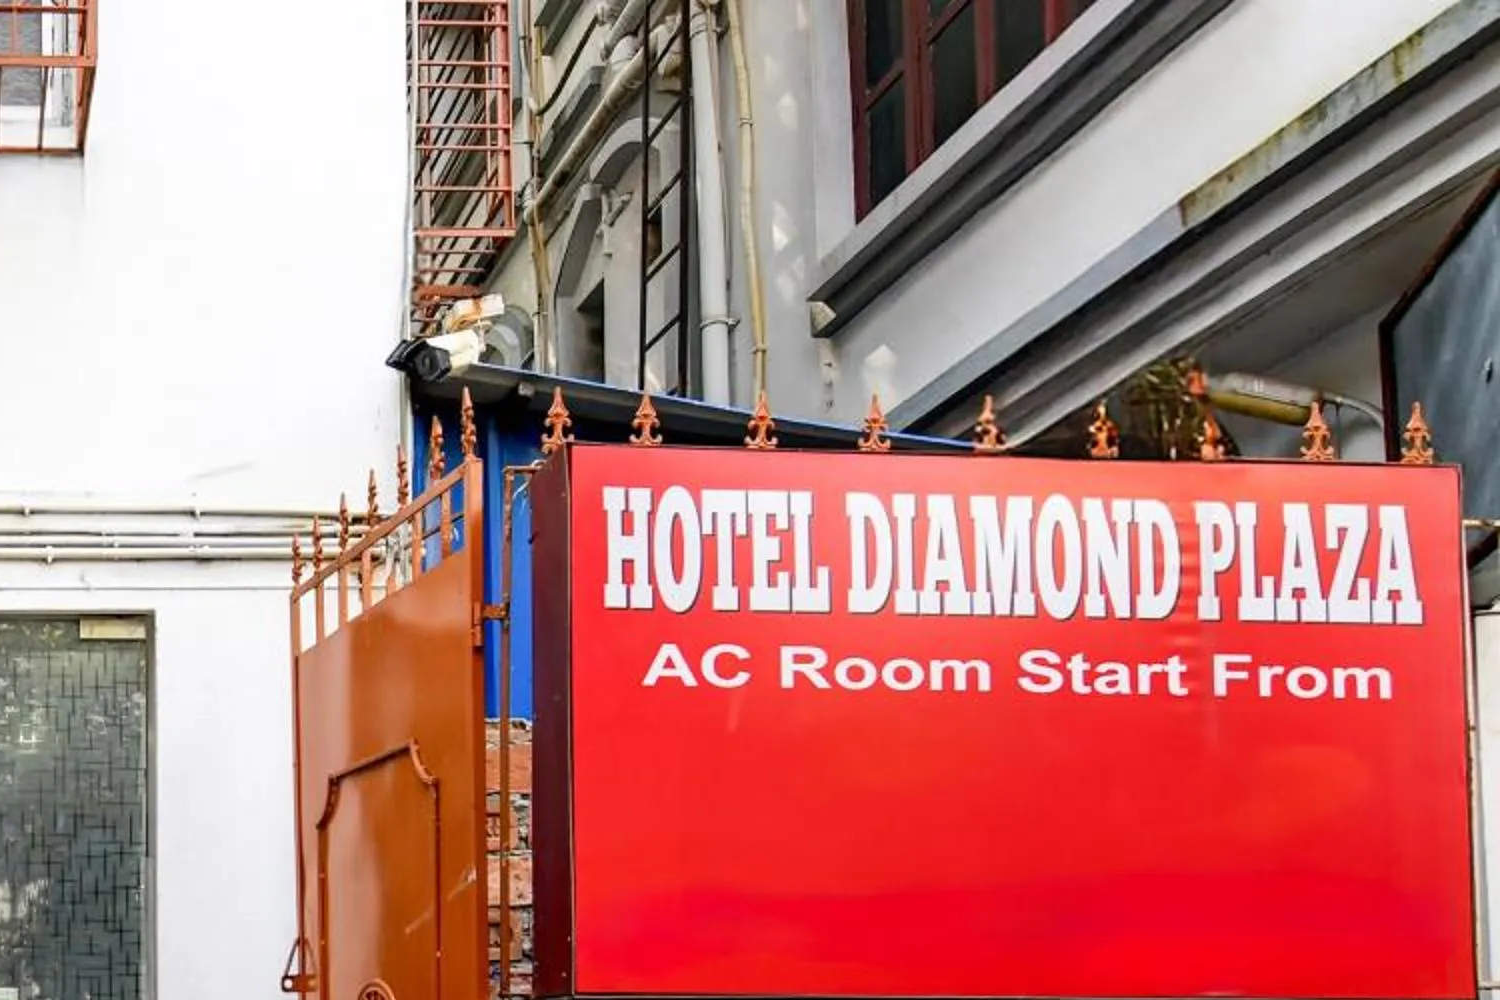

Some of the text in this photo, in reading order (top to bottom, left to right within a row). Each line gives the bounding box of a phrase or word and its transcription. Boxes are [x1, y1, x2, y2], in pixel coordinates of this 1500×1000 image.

[602, 485, 1424, 626] HOTEL DIAMOND PLAZA
[643, 643, 1392, 700] AC Room Start From
